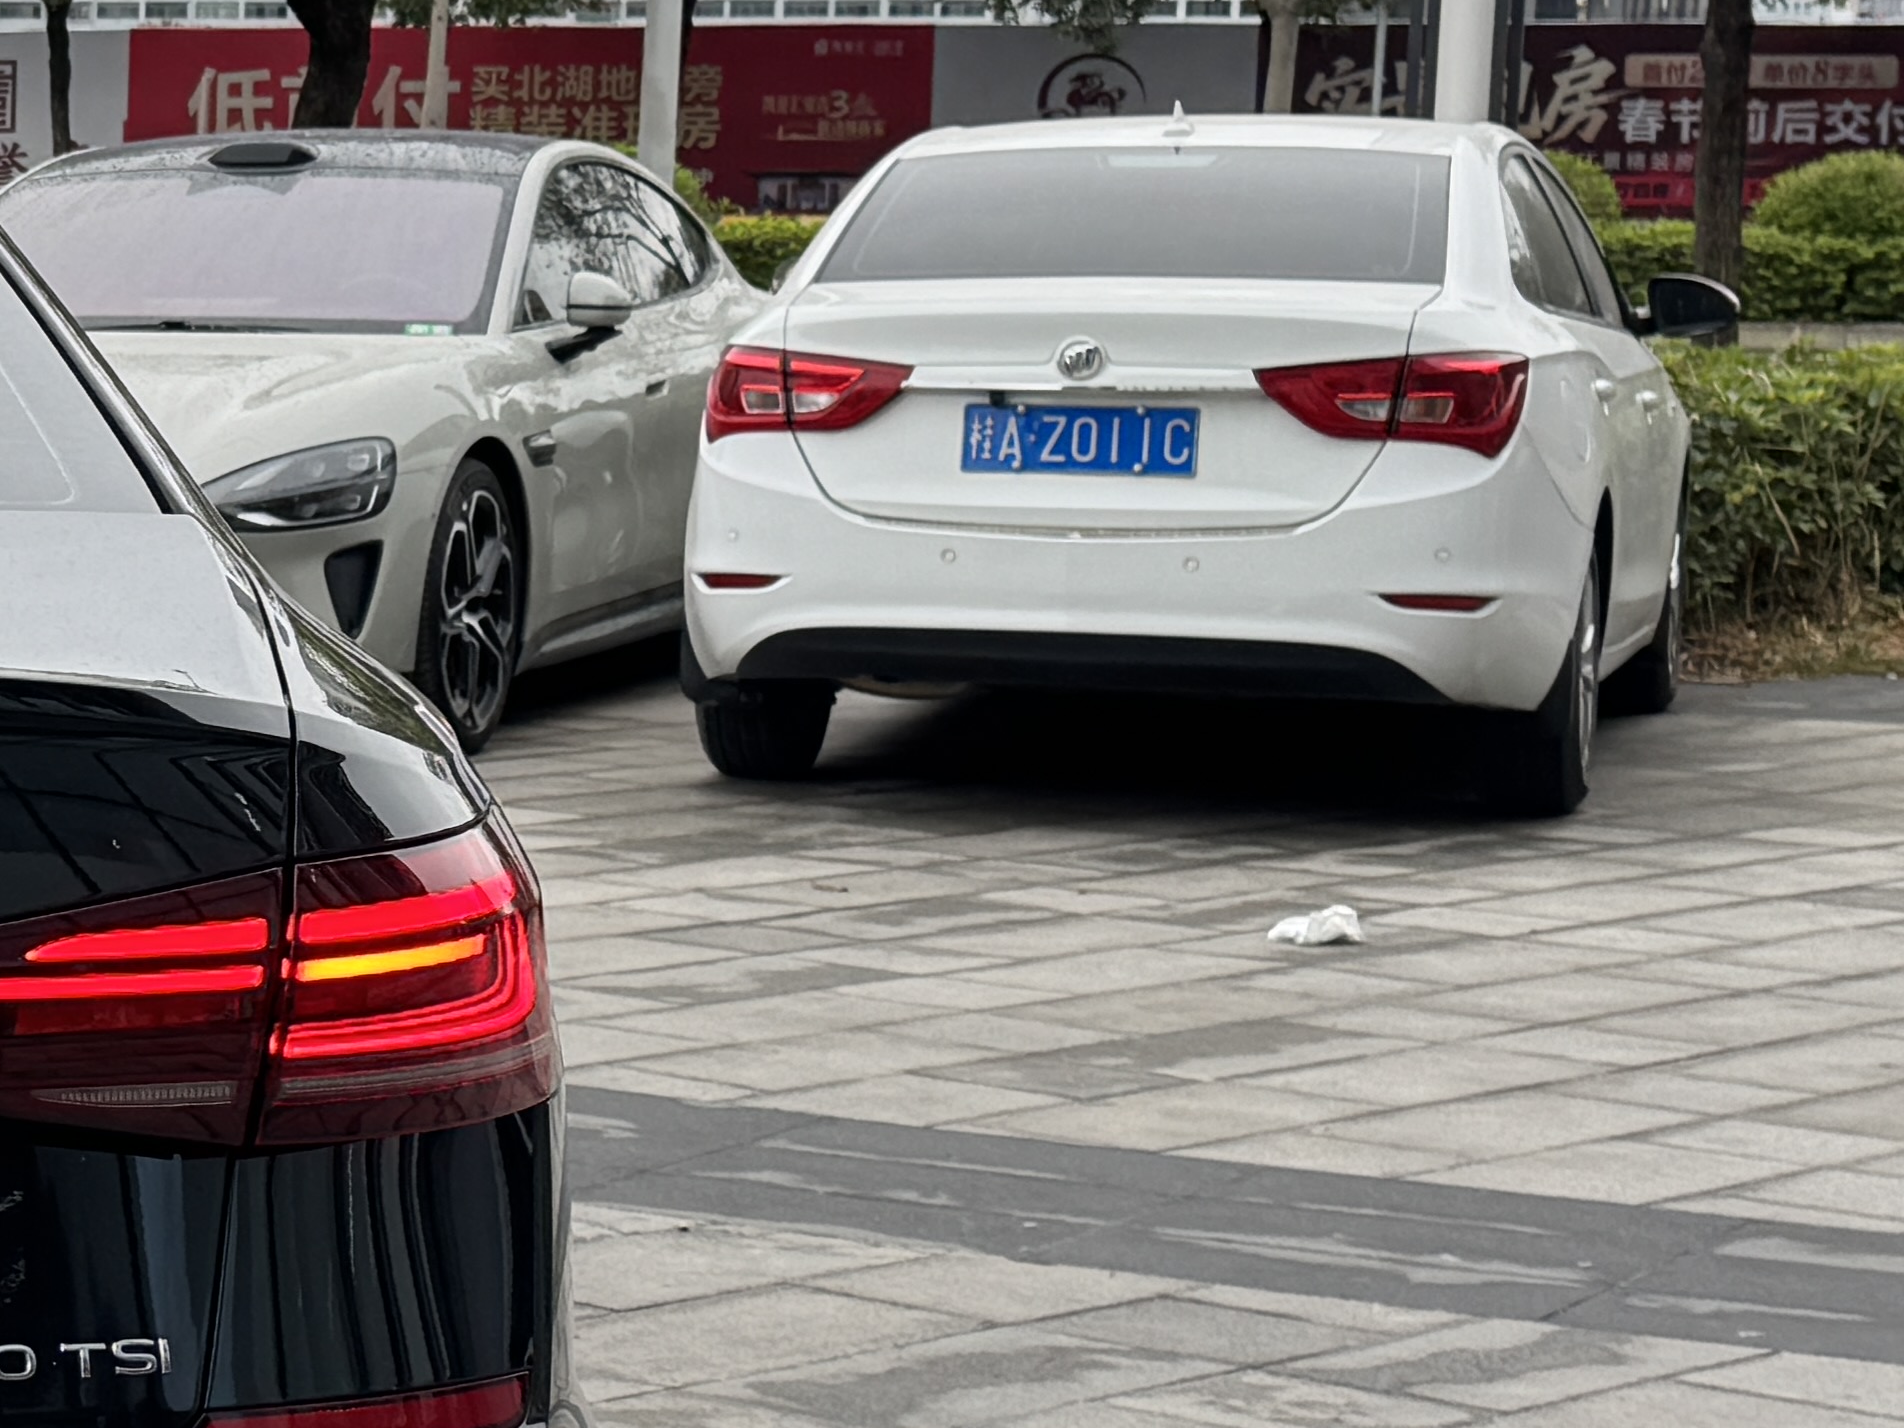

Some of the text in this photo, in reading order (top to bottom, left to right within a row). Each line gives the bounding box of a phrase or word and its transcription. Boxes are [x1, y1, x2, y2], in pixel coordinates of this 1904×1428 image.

[187, 65, 461, 134] 低付
[471, 64, 724, 103] 买北湖地旁
[59, 1337, 173, 1378] TSI
